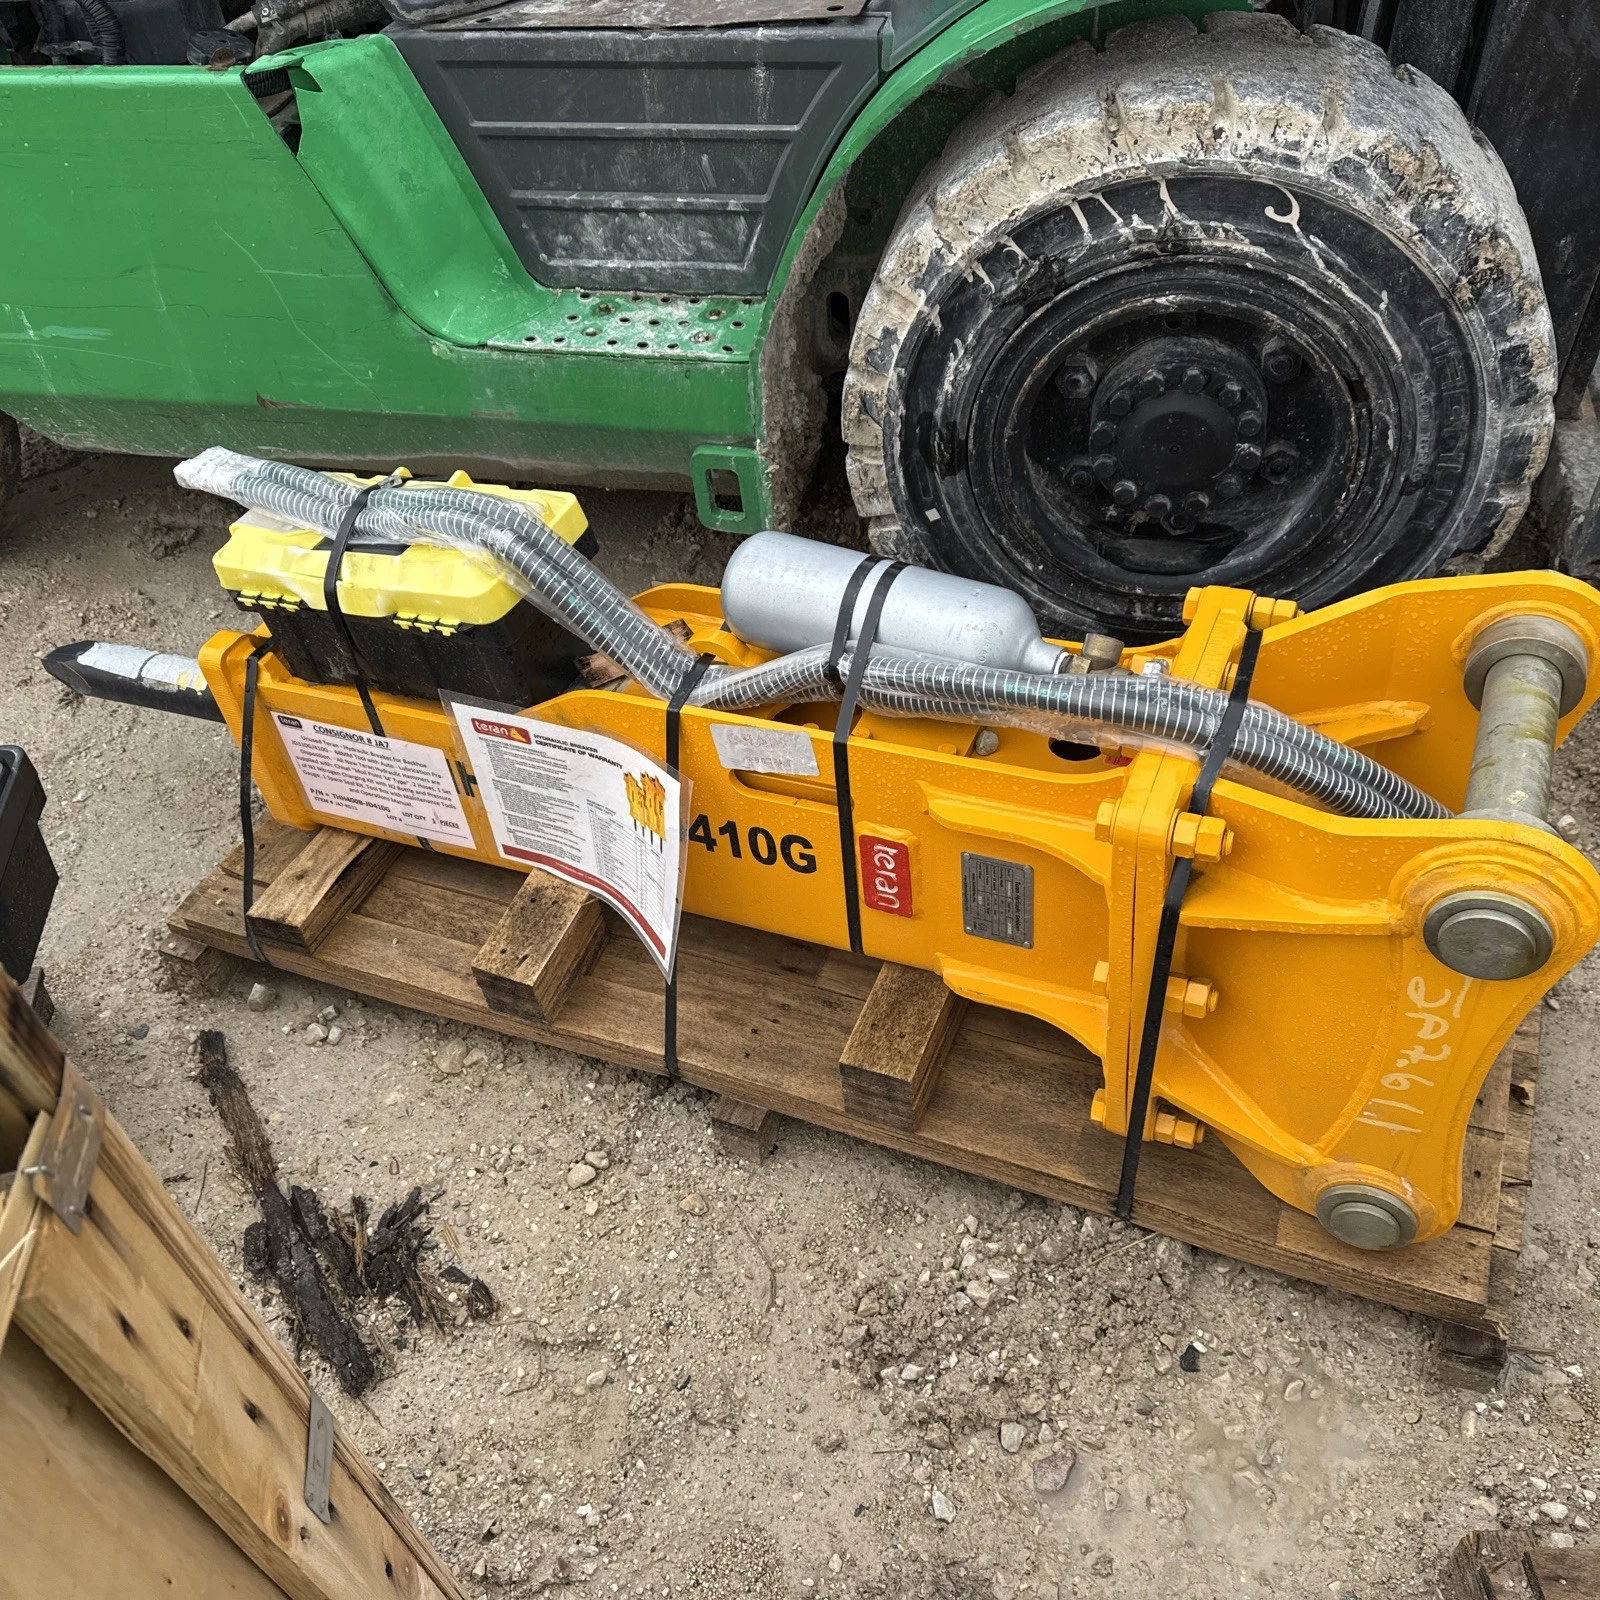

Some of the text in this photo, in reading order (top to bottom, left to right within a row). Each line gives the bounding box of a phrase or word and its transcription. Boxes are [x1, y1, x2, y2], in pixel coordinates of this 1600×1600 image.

[280, 717, 299, 726] teran
[474, 720, 509, 737] teran
[313, 725, 365, 742] CONSIGNOR
[375, 740, 389, 748] JA7
[534, 733, 569, 747] HYDRAULIC
[570, 742, 598, 753] BREAKER
[296, 756, 319, 764] supplied
[301, 736, 322, 744] Unused
[323, 740, 339, 748] Teran
[343, 745, 369, 755] Hydraulic
[370, 752, 392, 761] Breaker
[403, 759, 427, 768] Backhoe
[535, 740, 577, 755] CERTIFICATE
[587, 750, 623, 770] WARRANTY
[358, 762, 374, 770] Teran
[375, 767, 401, 777] Hydraulic
[402, 774, 430, 783] Hammers
[398, 766, 430, 775] Lubrication
[310, 788, 324, 796] P/N
[317, 767, 340, 775] Nitrogen
[342, 772, 366, 783] Charging
[397, 786, 414, 794] Bottle
[427, 792, 452, 802] Pressure
[327, 775, 343, 783] Spare
[403, 794, 440, 805] Maintenance
[441, 802, 456, 810] Tools
[361, 790, 390, 801] Operations
[440, 820, 459, 829] PIECES
[688, 813, 817, 874] 410G
[873, 843, 901, 909] teran
